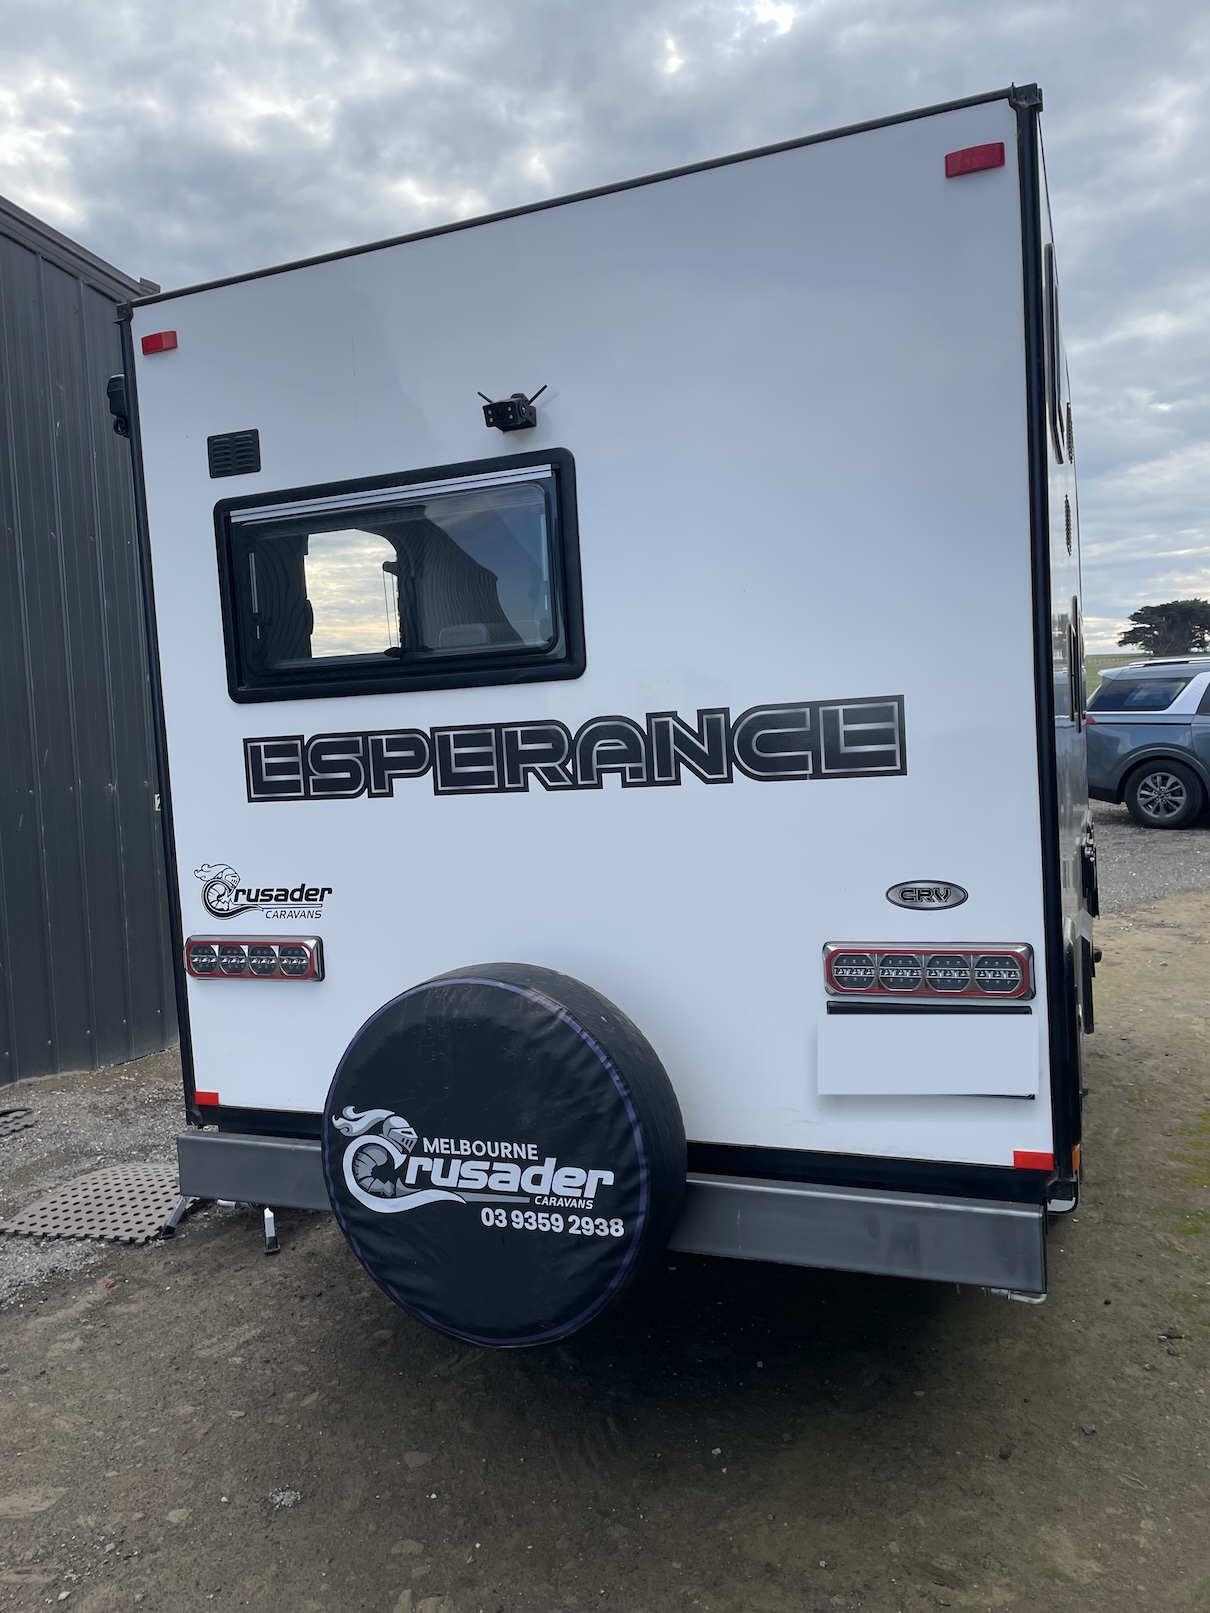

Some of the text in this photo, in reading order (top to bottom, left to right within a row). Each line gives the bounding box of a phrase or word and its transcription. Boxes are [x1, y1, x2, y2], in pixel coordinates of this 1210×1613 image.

[243, 695, 907, 803] ESPERANCE
[898, 887, 951, 903] CRV
[265, 910, 322, 919] CARAVANS
[423, 1137, 539, 1161] MELBOURNE
[534, 1195, 594, 1210] CARAVANS
[480, 1207, 625, 1238] 03 9359 2938
